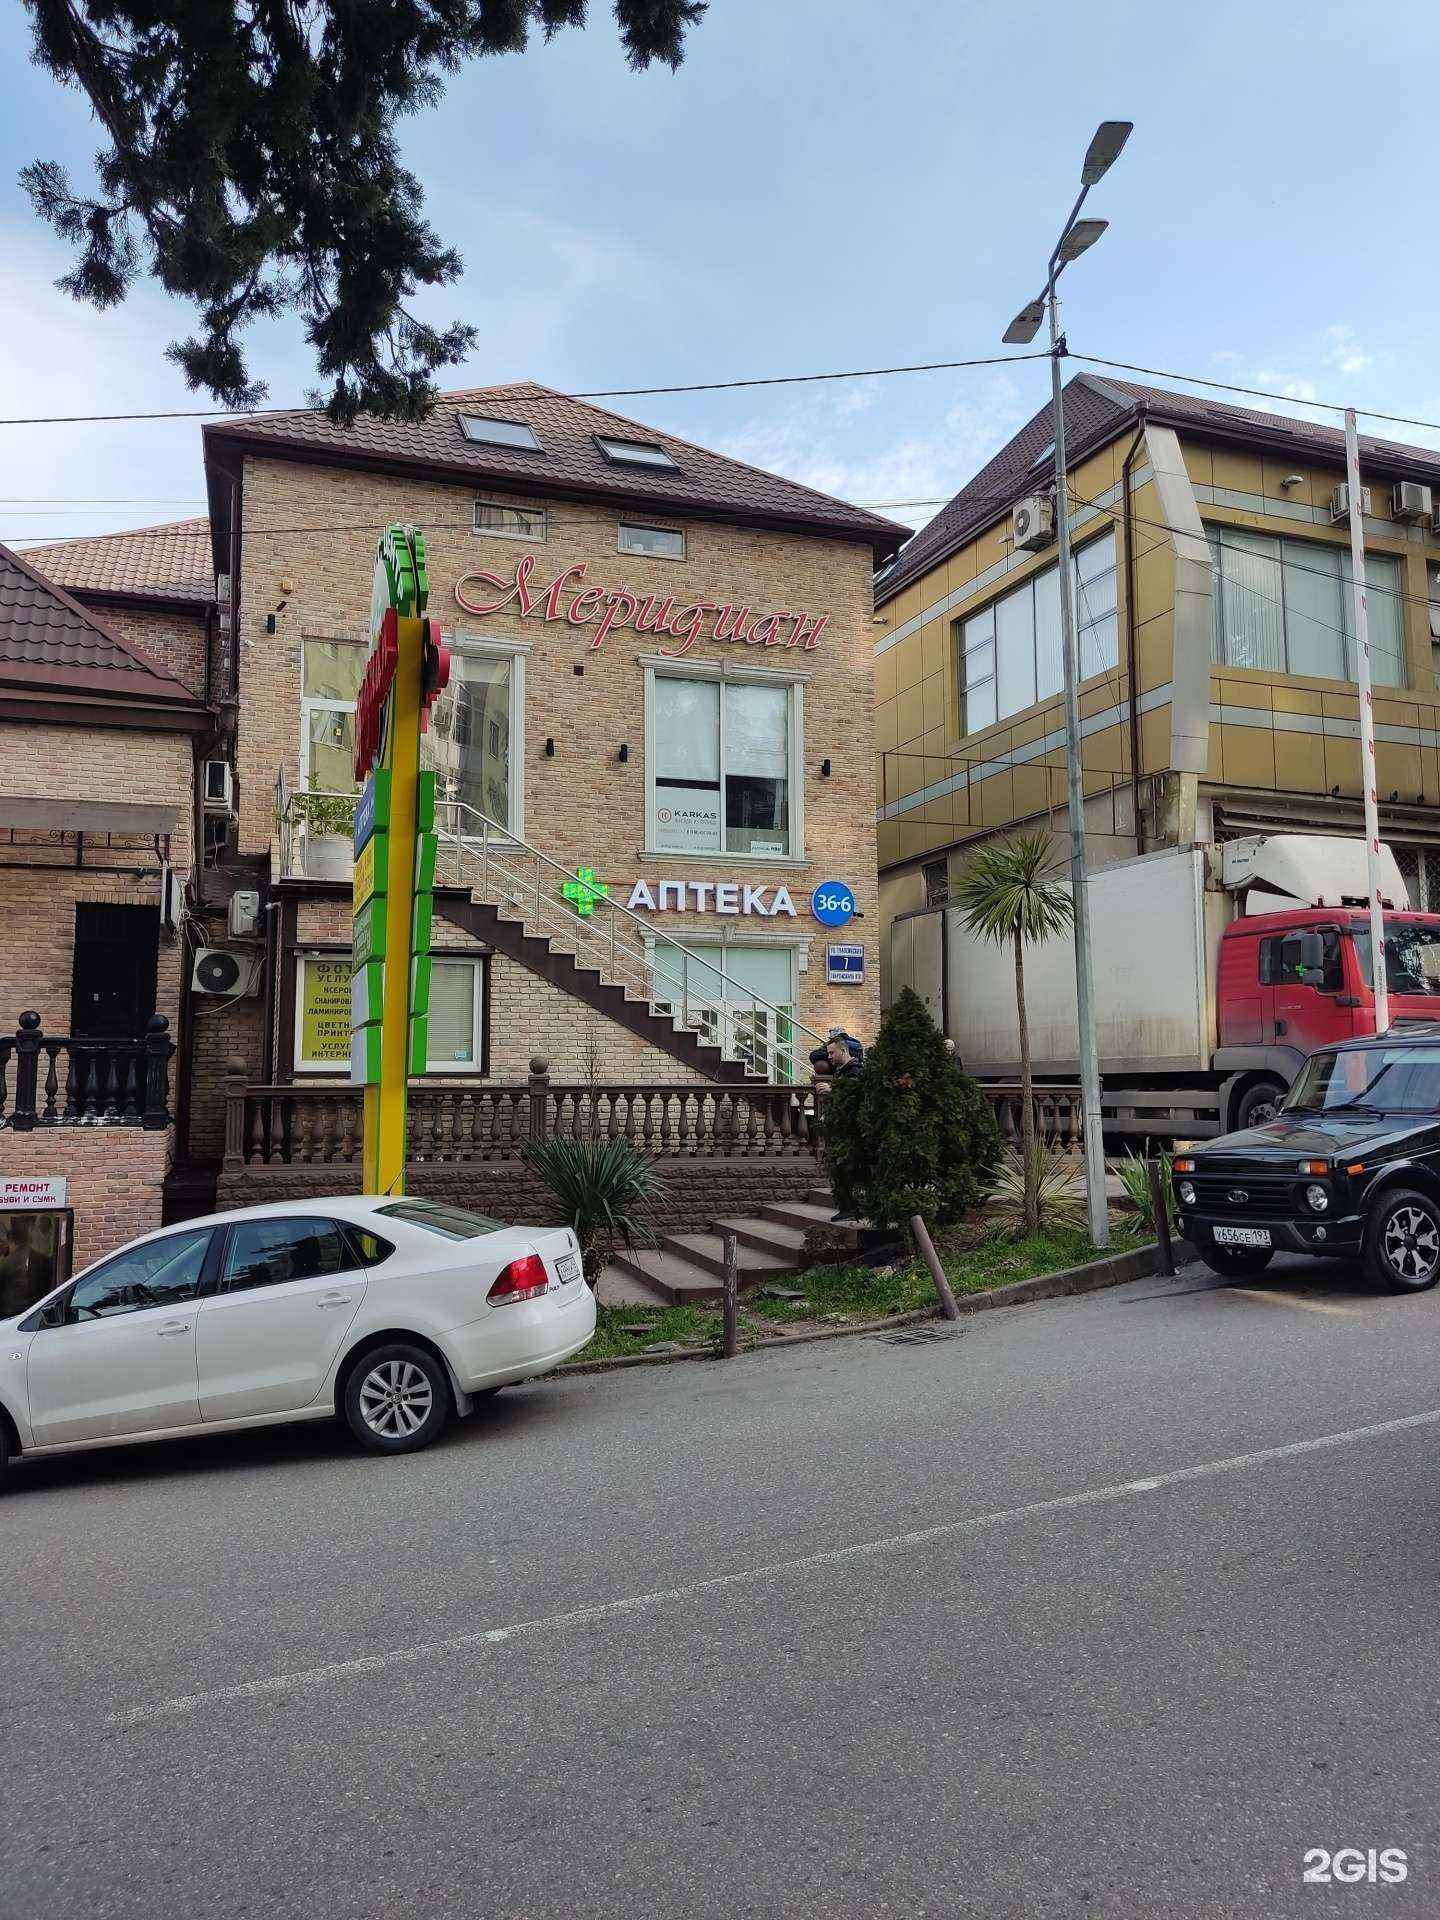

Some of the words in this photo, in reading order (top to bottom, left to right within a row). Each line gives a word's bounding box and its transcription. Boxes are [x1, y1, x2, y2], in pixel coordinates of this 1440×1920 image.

[455, 554, 831, 657] Меридиан
[674, 809, 717, 820] KARKAS
[626, 878, 798, 917] АПТЕКА
[843, 957, 849, 970] 7
[5, 1183, 50, 1193] РЕМОНТ
